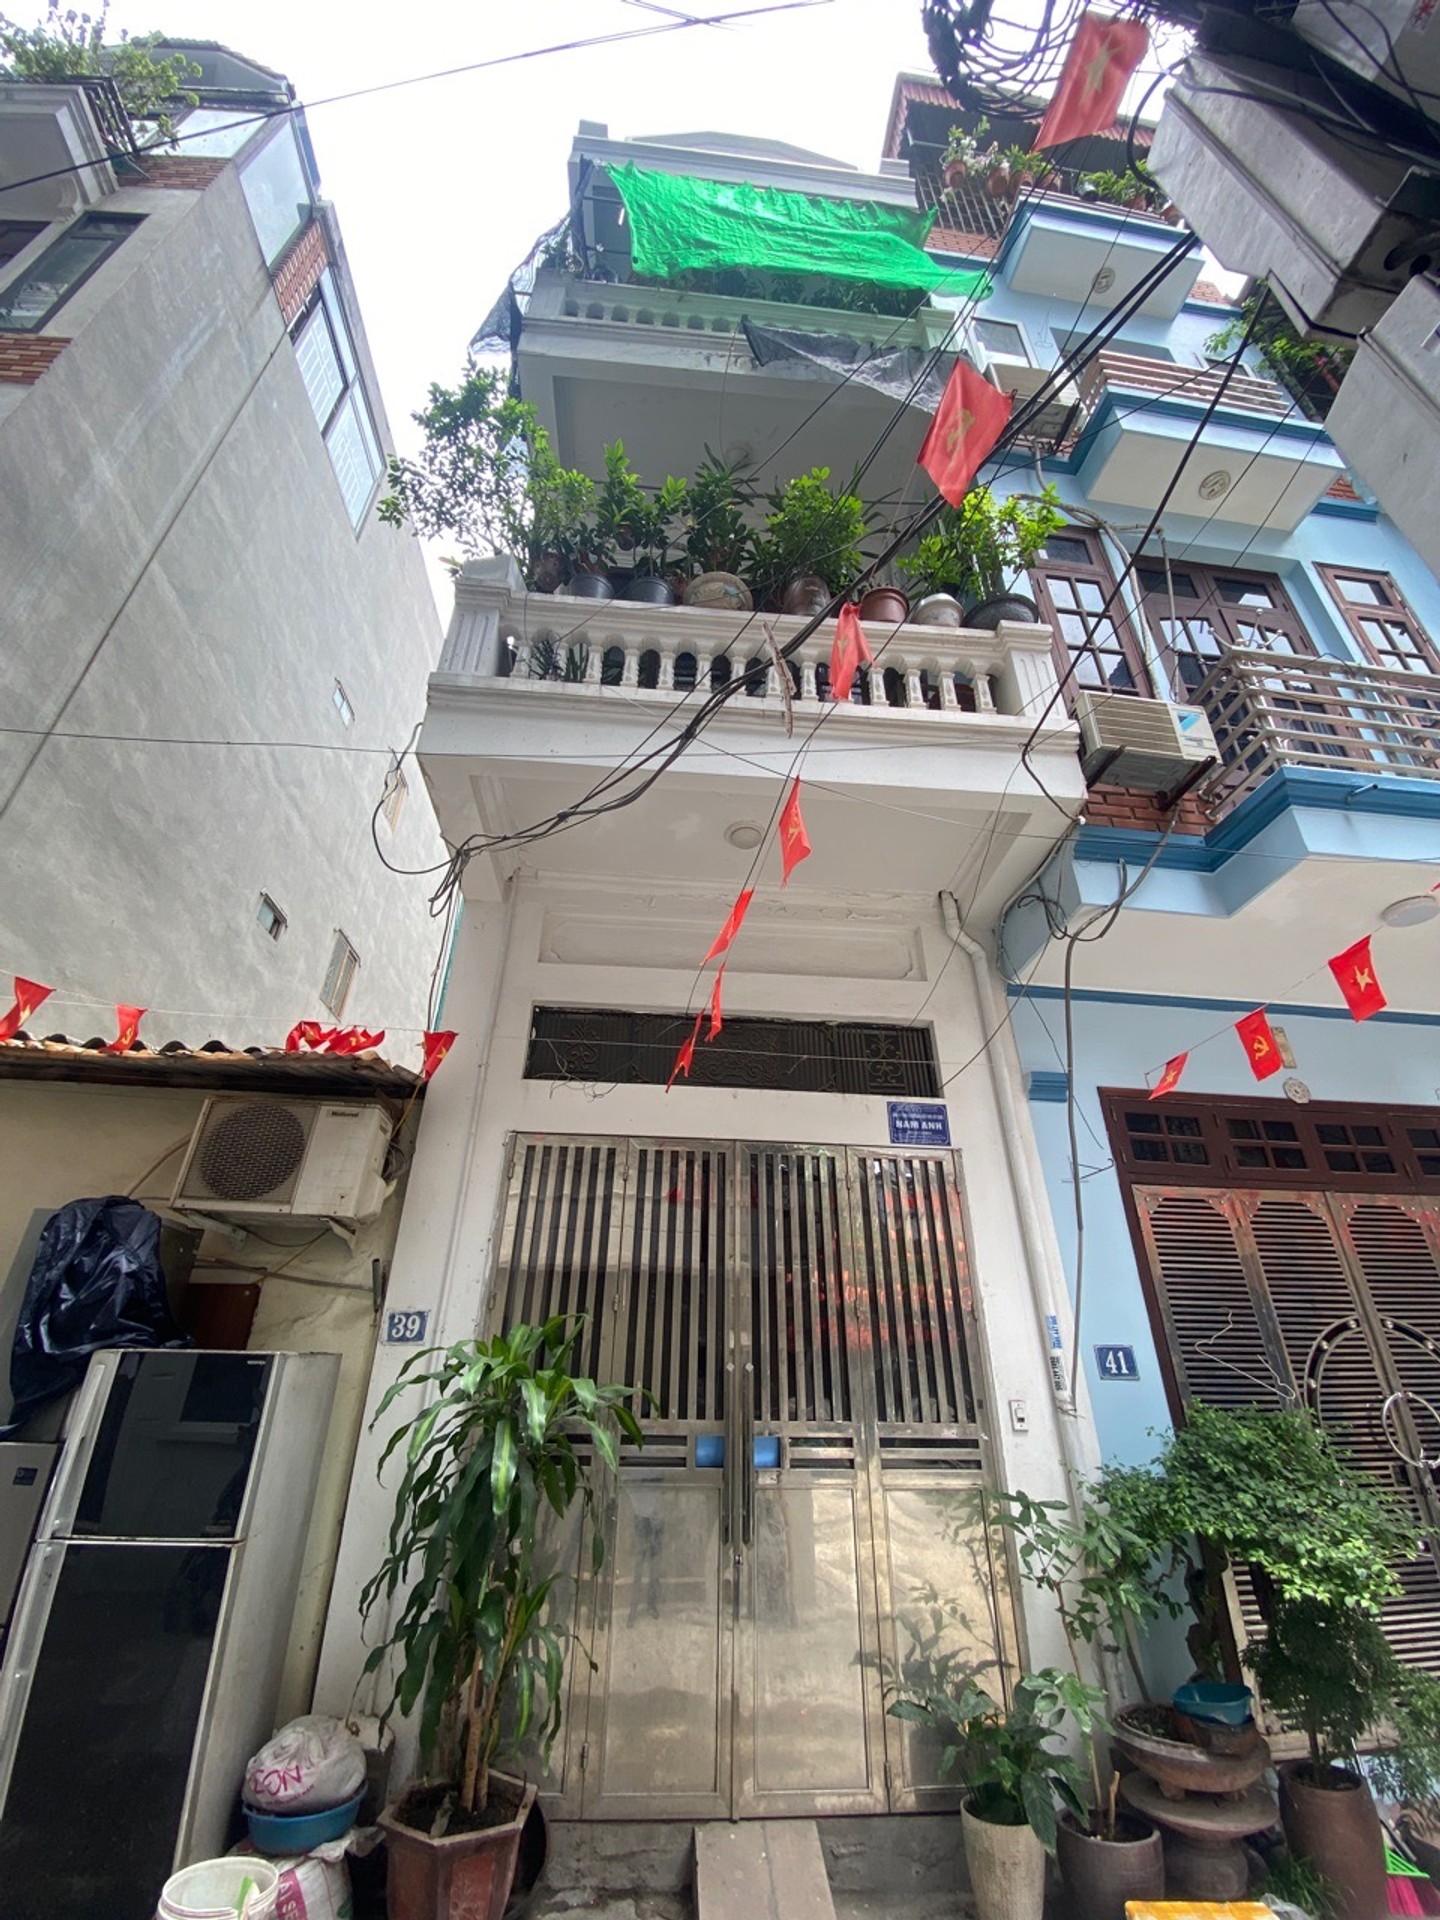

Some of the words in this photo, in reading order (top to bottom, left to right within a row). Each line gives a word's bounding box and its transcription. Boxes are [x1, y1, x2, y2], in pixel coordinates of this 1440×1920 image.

[896, 1120, 919, 1129] NAM
[921, 1121, 942, 1130] ANH
[391, 1314, 421, 1338] 39
[1105, 1350, 1129, 1374] 41
